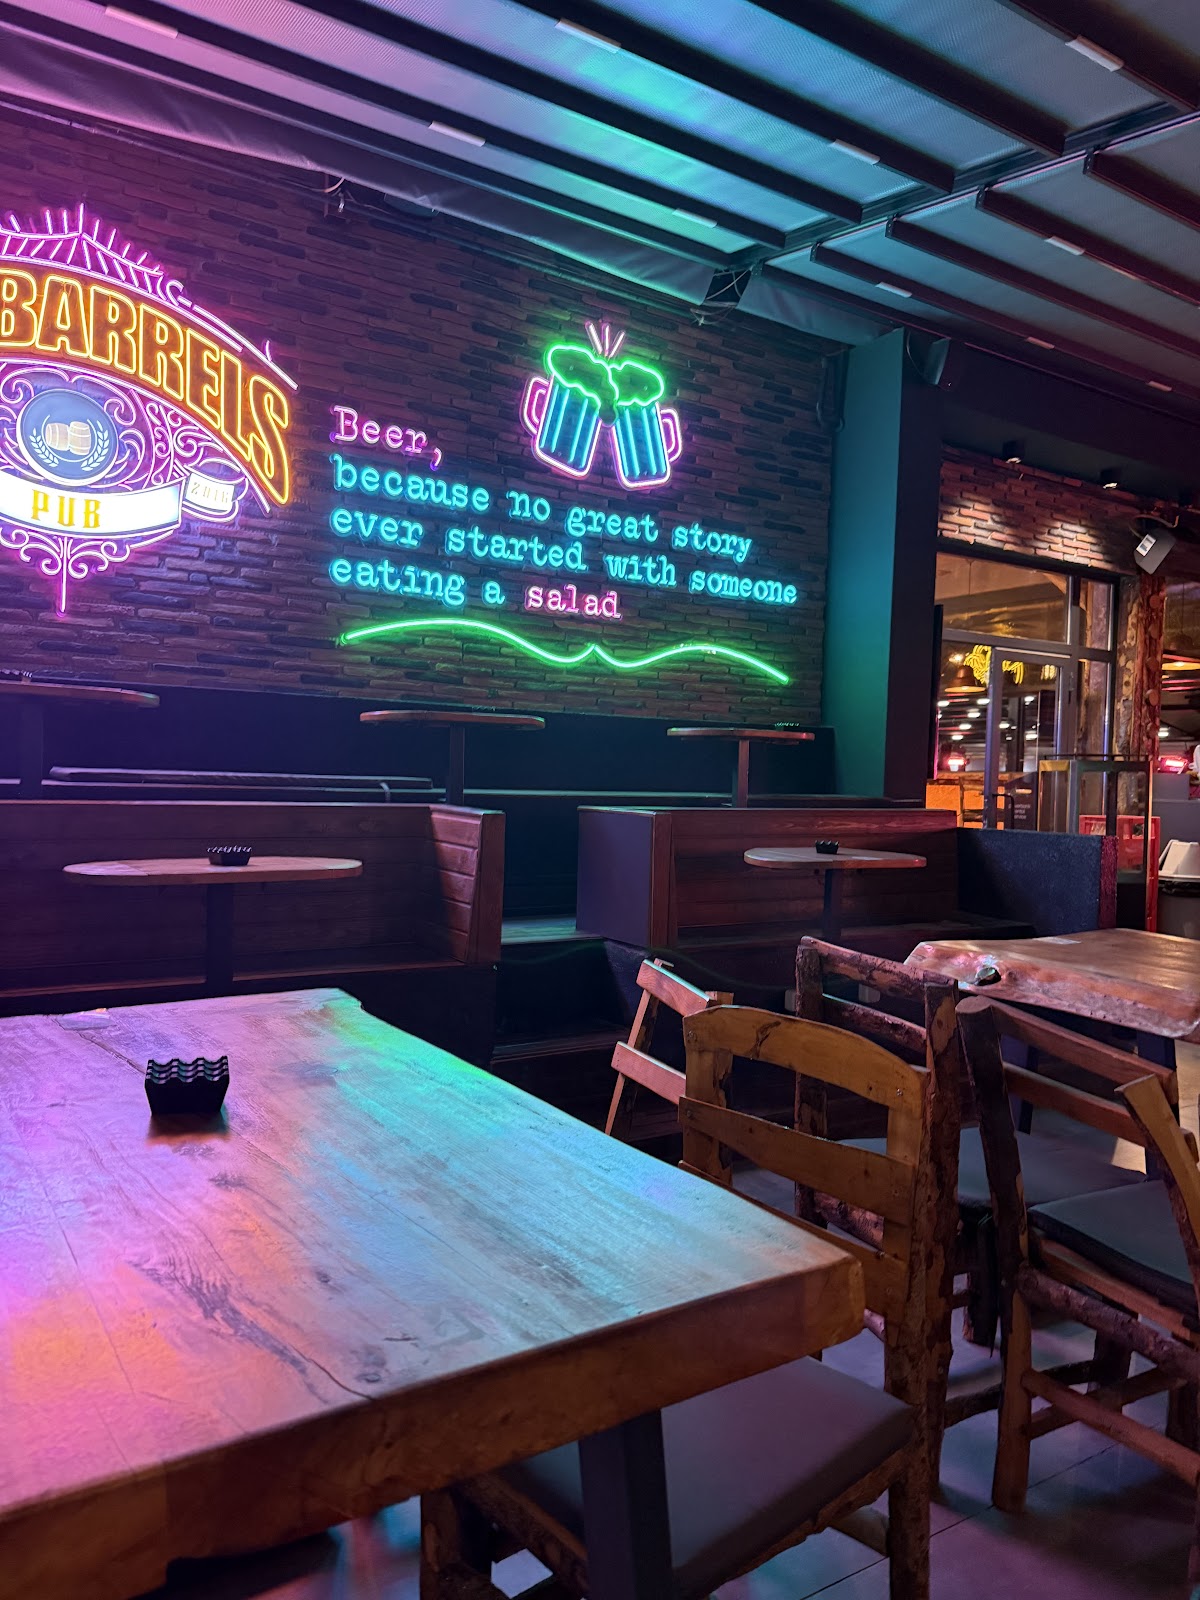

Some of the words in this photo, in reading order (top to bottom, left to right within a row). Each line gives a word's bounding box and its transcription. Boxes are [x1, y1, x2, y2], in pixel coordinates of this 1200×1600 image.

[0, 269, 290, 504] BARRELS
[332, 405, 442, 468] Beer,
[31, 489, 101, 528] PUB
[330, 454, 490, 511] because
[507, 490, 551, 522] no
[566, 507, 659, 542] great
[673, 523, 753, 563] story
[330, 558, 466, 606] eating
[482, 580, 506, 605] a
[525, 584, 622, 619] salad
[331, 507, 423, 547] ever
[446, 525, 589, 572] started
[604, 554, 677, 587] with
[689, 569, 798, 604] someone
